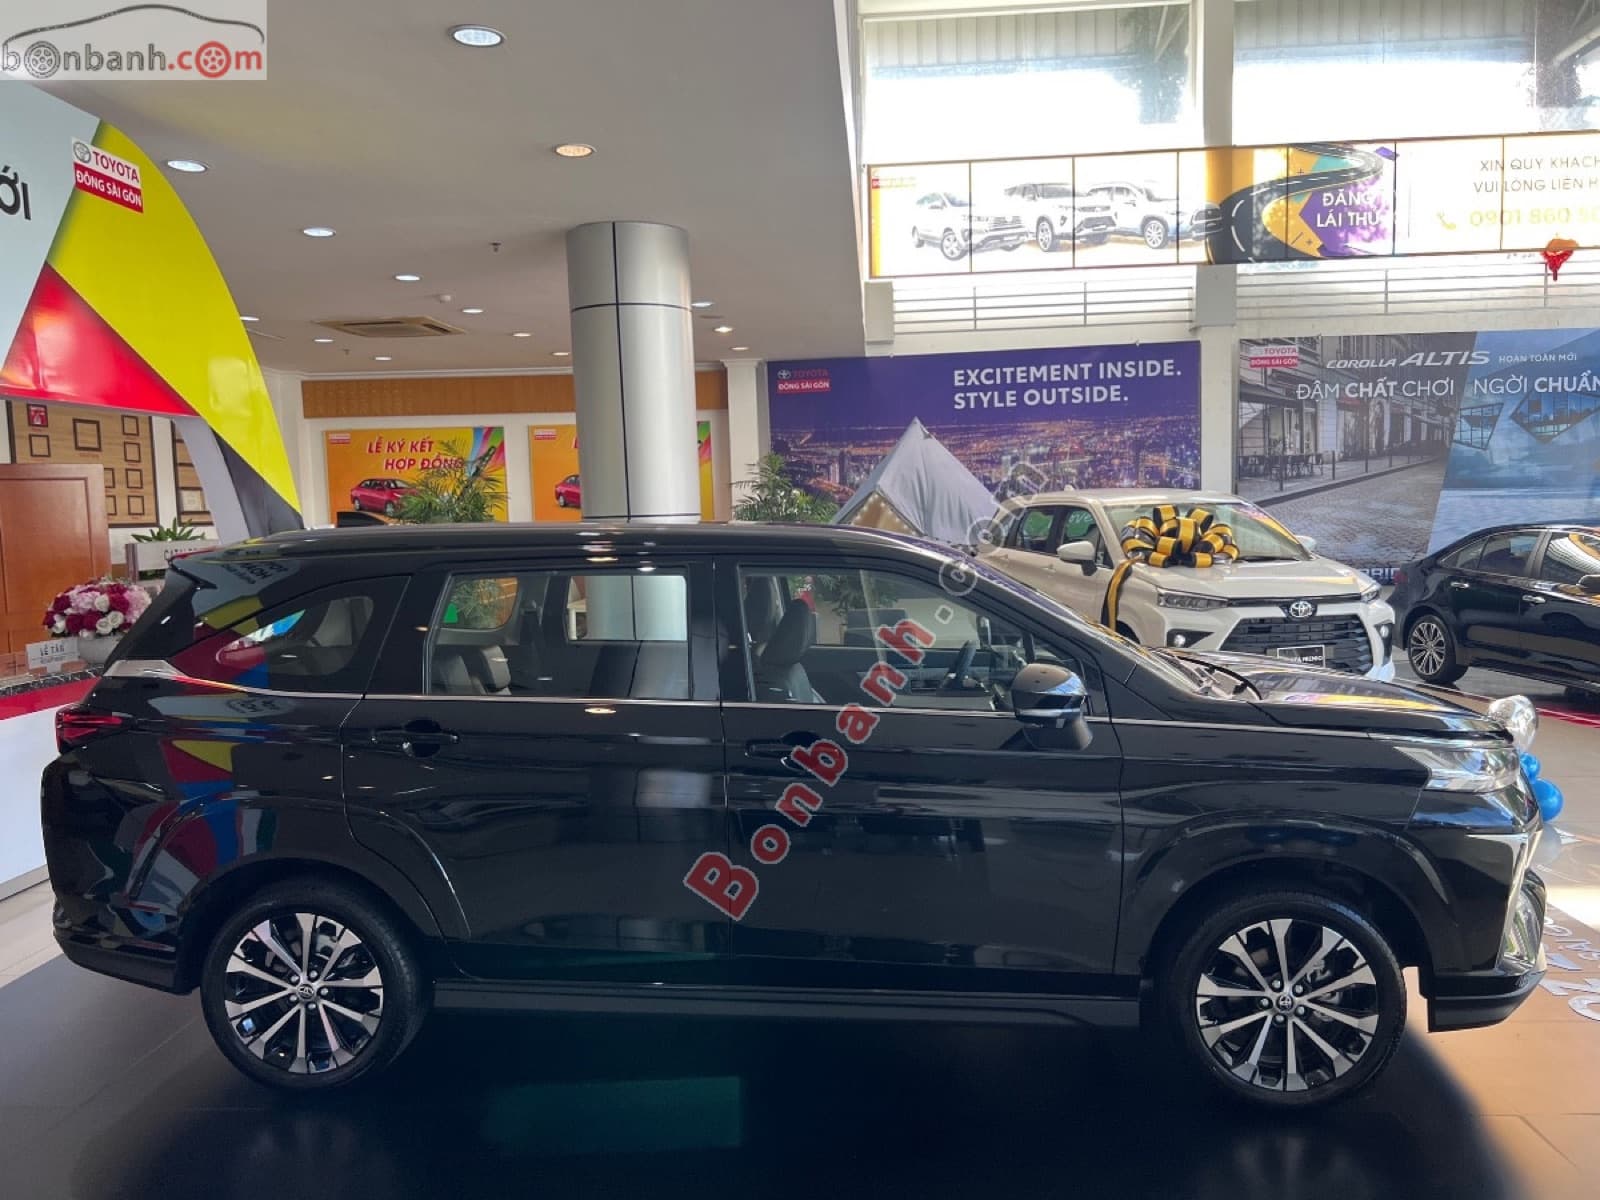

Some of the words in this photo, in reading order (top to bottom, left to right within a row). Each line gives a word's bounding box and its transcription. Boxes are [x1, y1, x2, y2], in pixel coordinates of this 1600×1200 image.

[92, 150, 140, 183] TOYOTA
[76, 170, 105, 192] ĐÔNG
[106, 181, 121, 199] SÀI
[122, 188, 142, 207] GÒN
[1473, 181, 1498, 193] VUI
[1316, 208, 1342, 228] LÁI
[1264, 347, 1296, 356] TOYOTA
[1326, 358, 1397, 369] COROLLA
[1400, 351, 1490, 367] ALTIS
[793, 369, 829, 378] TOYOTA
[953, 363, 1093, 387] EXCITEMENT
[1099, 359, 1182, 379] INSIDE.
[1345, 376, 1398, 398] CHẤT
[1402, 376, 1455, 397] CHƠI
[1474, 373, 1528, 394] NGỜI
[953, 390, 1017, 410] STYLE
[1023, 384, 1129, 407] OUTSIDE.
